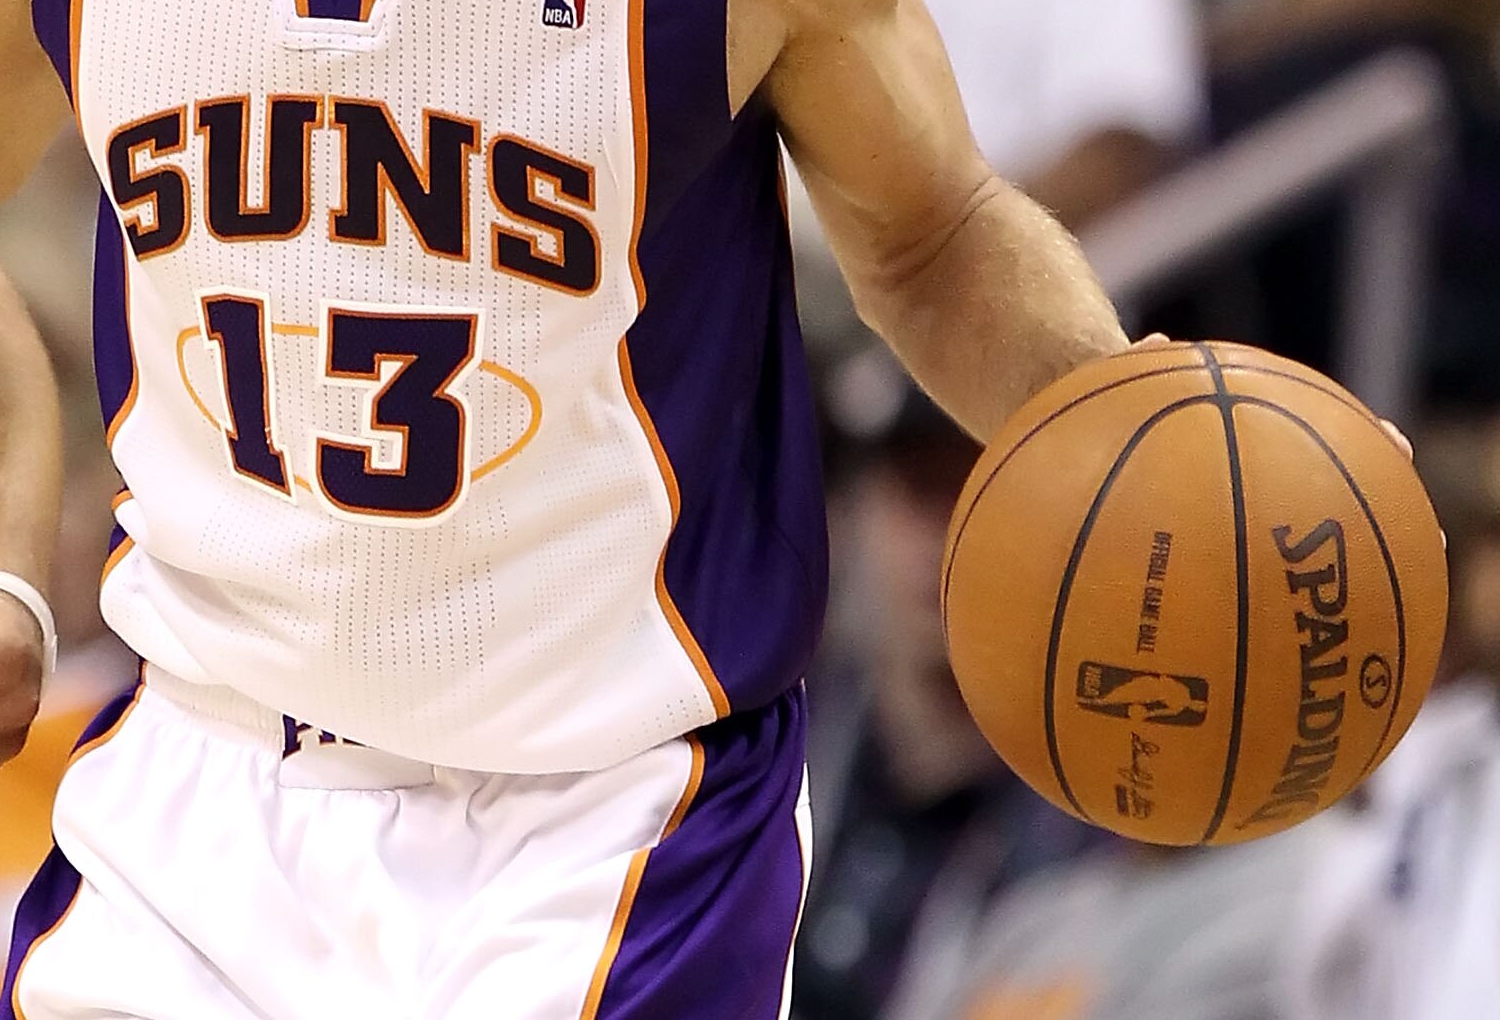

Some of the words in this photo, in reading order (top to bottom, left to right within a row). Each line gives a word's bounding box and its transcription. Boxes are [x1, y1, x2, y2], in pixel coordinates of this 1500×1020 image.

[544, 8, 572, 26] NBA
[106, 93, 603, 299] SUNS
[200, 286, 486, 529] 13
[1146, 530, 1173, 582] OFFICIAL
[1141, 586, 1163, 621] GAME
[1136, 623, 1157, 654] BALL
[1082, 665, 1102, 697] NBA
[1236, 519, 1349, 831] SPALDING
